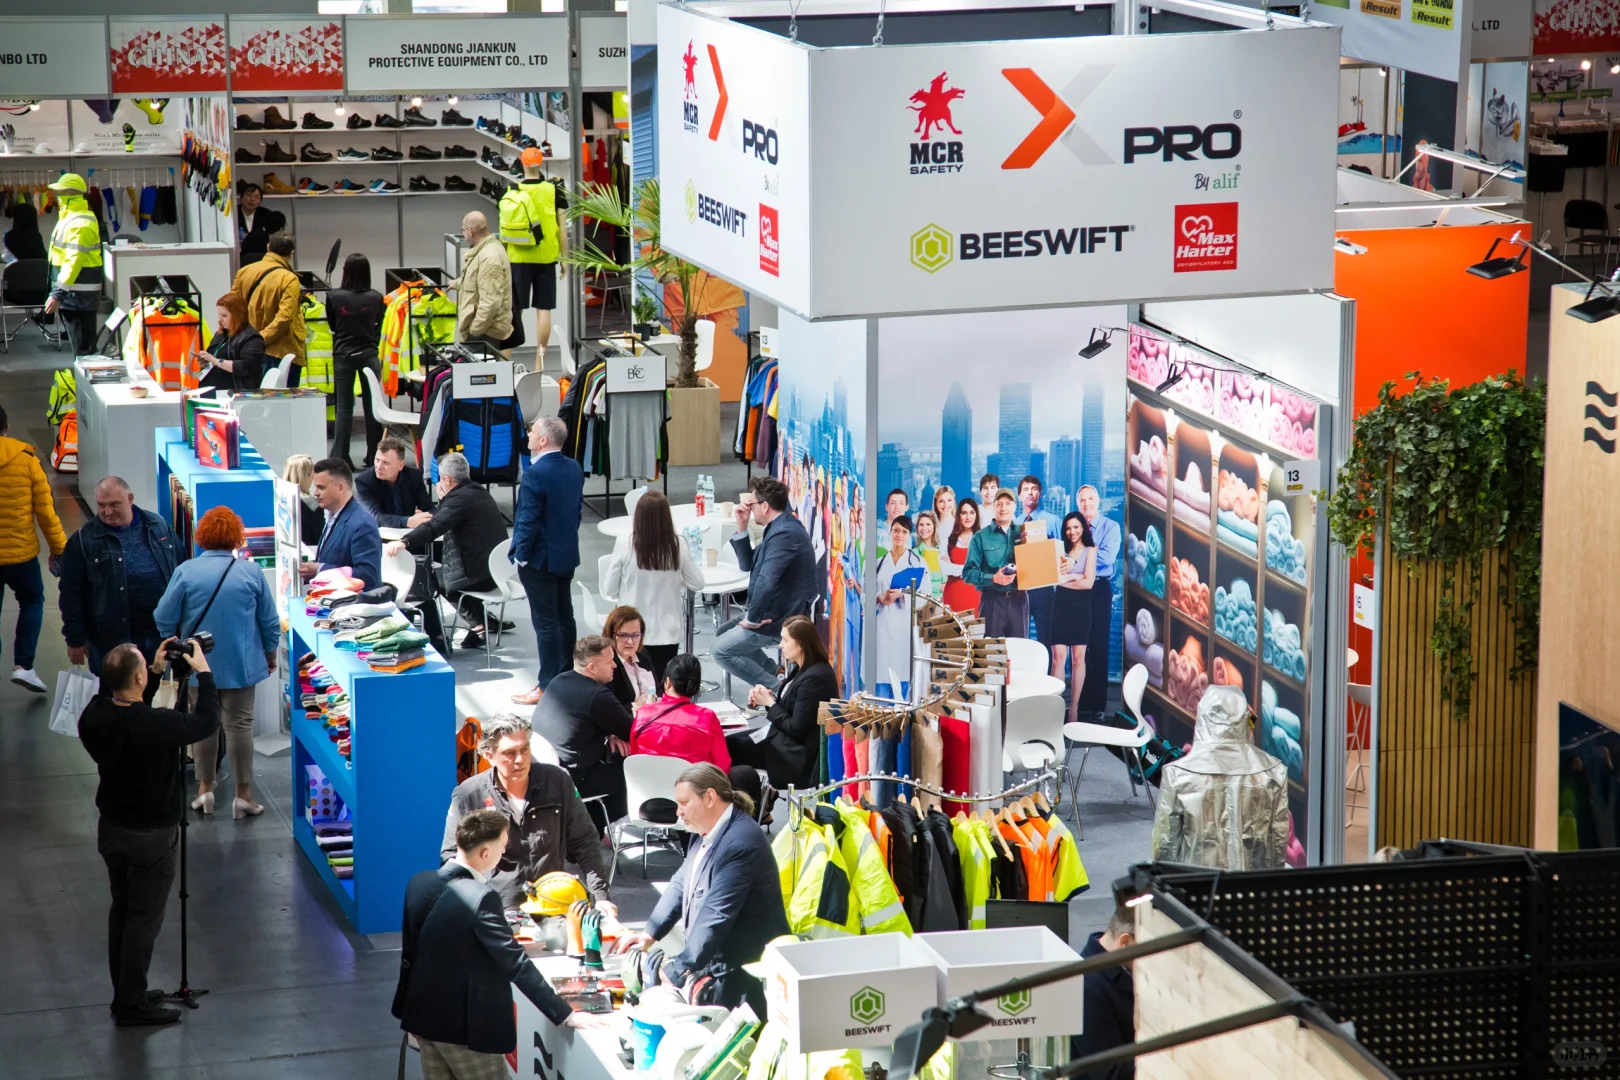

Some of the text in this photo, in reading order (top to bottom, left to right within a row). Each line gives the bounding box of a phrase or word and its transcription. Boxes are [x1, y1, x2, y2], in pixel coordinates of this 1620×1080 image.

[1365, 1, 1399, 16] Result
[1416, 11, 1451, 26] Result
[1482, 19, 1500, 31] LTD
[1549, 10, 1618, 31] CHINA
[127, 44, 209, 67] CHINA
[247, 43, 326, 66] CHINA
[400, 42, 517, 55] SHANDONG JIANKUN
[598, 47, 627, 58] SUZH
[26, 53, 48, 65] LTD
[368, 54, 548, 69] PROTECTIVE EQUIPMENT CO., LTD
[683, 100, 699, 126] MCR
[743, 118, 778, 166] PRO
[1123, 122, 1242, 165] PRO
[909, 140, 965, 165] MCR
[909, 164, 964, 175] SAFETY
[1195, 172, 1240, 191] By alif
[698, 192, 747, 238] BEESWIFT
[959, 224, 1131, 260] BEESWIFT
[1197, 230, 1236, 246] Max
[760, 243, 778, 262] Harter
[1176, 244, 1234, 260] Harter
[1287, 469, 1300, 482] 13
[990, 1016, 1038, 1028] BEESWIFT
[844, 1024, 892, 1038] BEESWIFT
